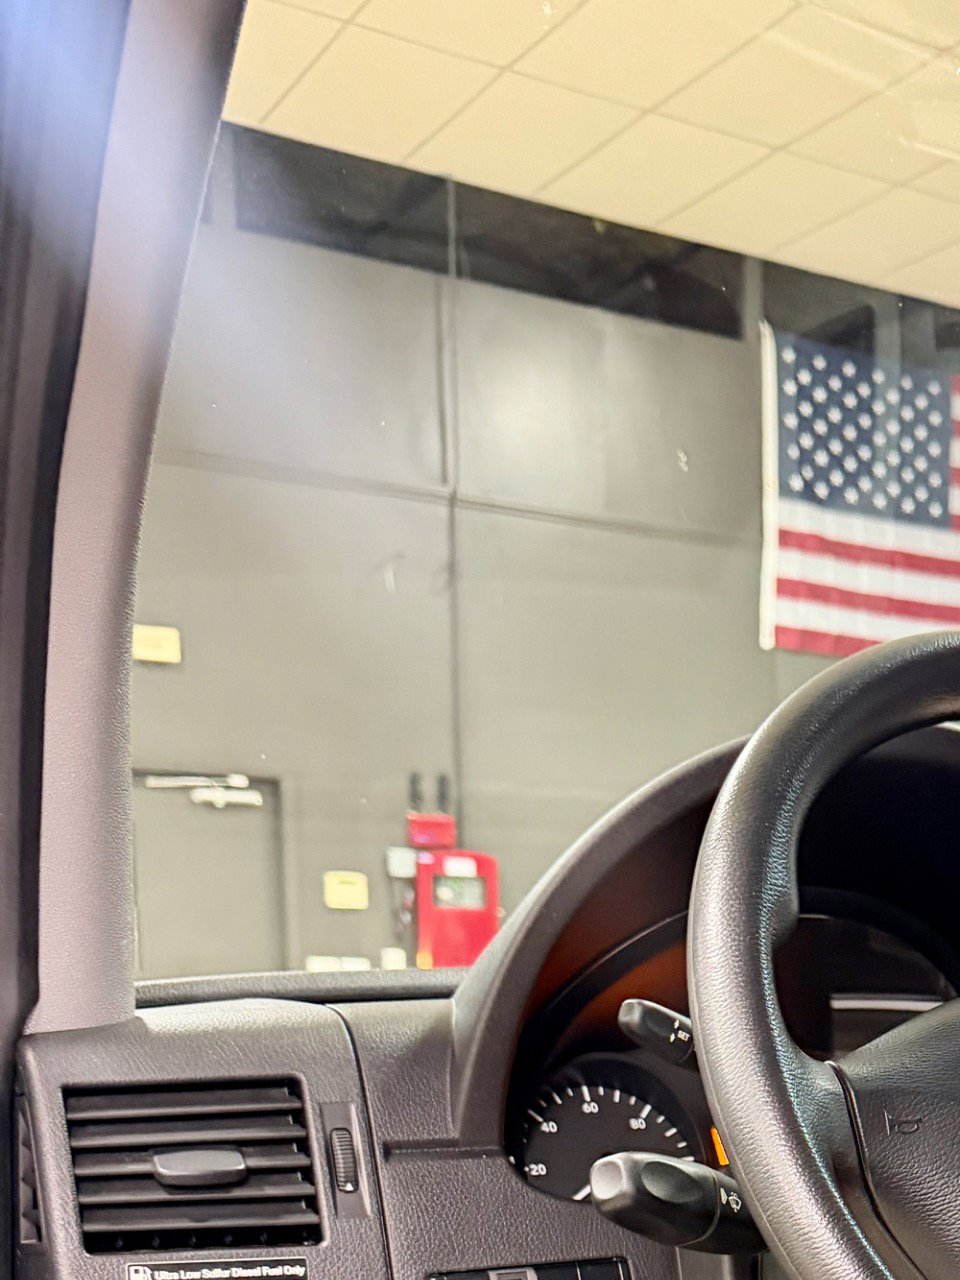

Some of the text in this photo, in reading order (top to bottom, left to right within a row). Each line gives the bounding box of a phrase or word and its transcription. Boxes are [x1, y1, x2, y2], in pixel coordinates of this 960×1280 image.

[582, 1101, 599, 1114] 60
[540, 1121, 558, 1133] 40
[629, 1117, 647, 1130] 80
[529, 1163, 547, 1176] 20
[153, 1270, 180, 1280] Ultra
[179, 1269, 201, 1280] Low
[230, 1267, 262, 1278] Diesel
[261, 1265, 283, 1277] Fuel
[283, 1264, 306, 1277] Only
